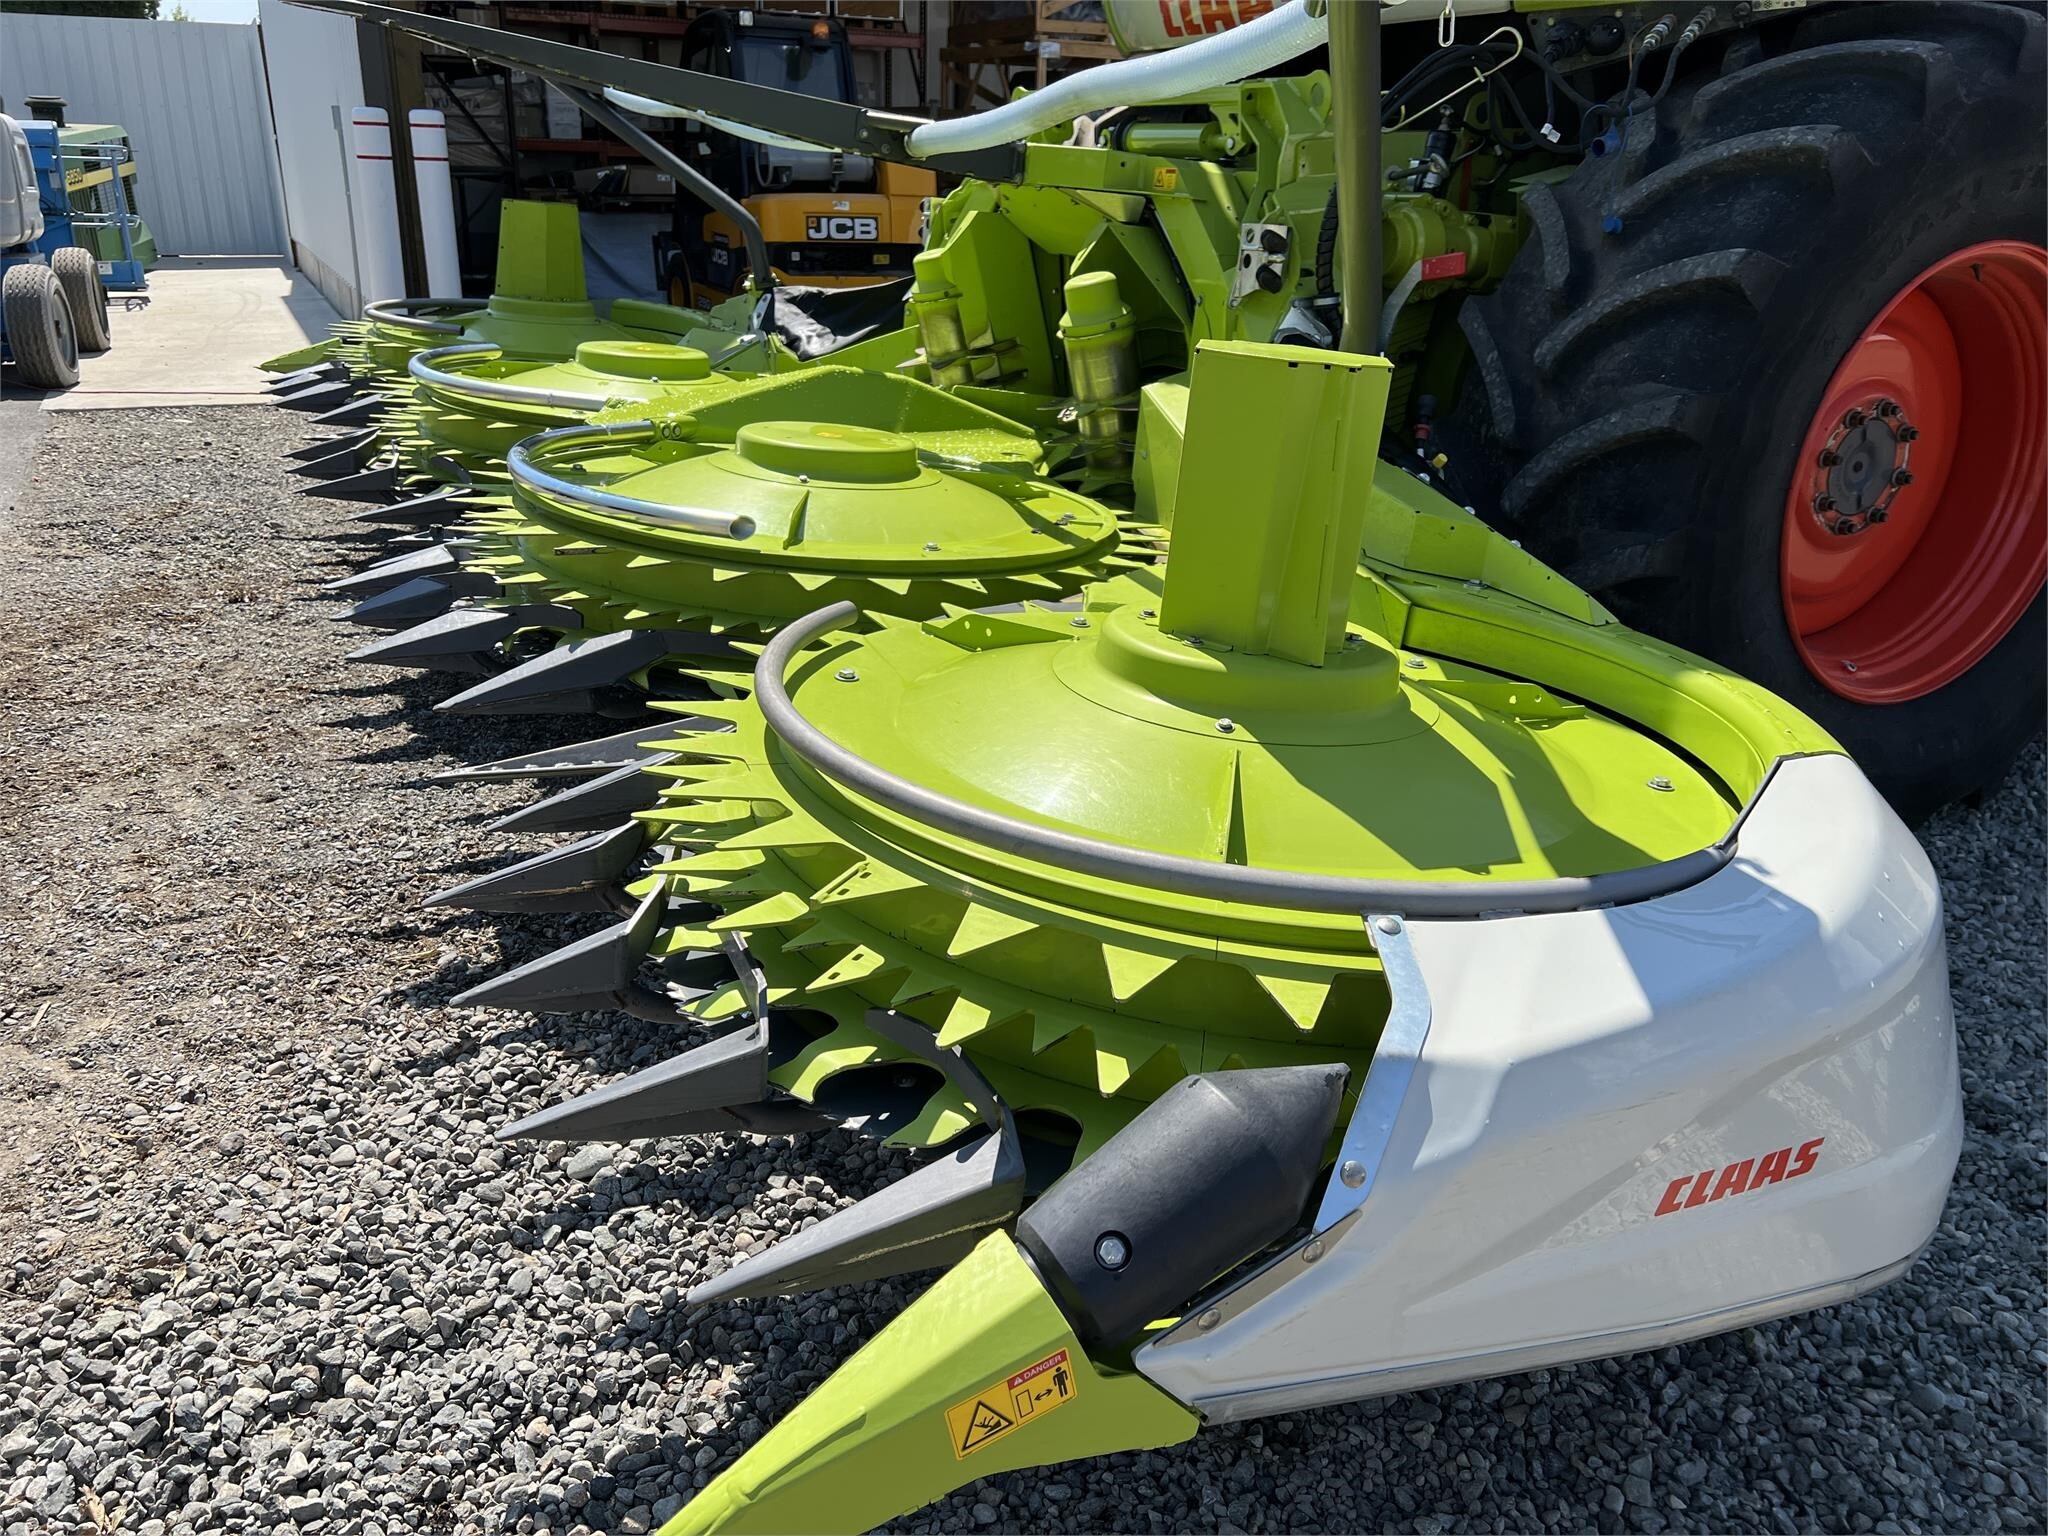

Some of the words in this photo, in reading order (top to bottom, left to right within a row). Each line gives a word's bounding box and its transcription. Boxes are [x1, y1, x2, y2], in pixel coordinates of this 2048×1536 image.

[808, 217, 878, 239] JCB
[711, 248, 729, 266] JCB
[1655, 1137, 1825, 1216] CLAAS
[1023, 1354, 1062, 1380] DANGER
